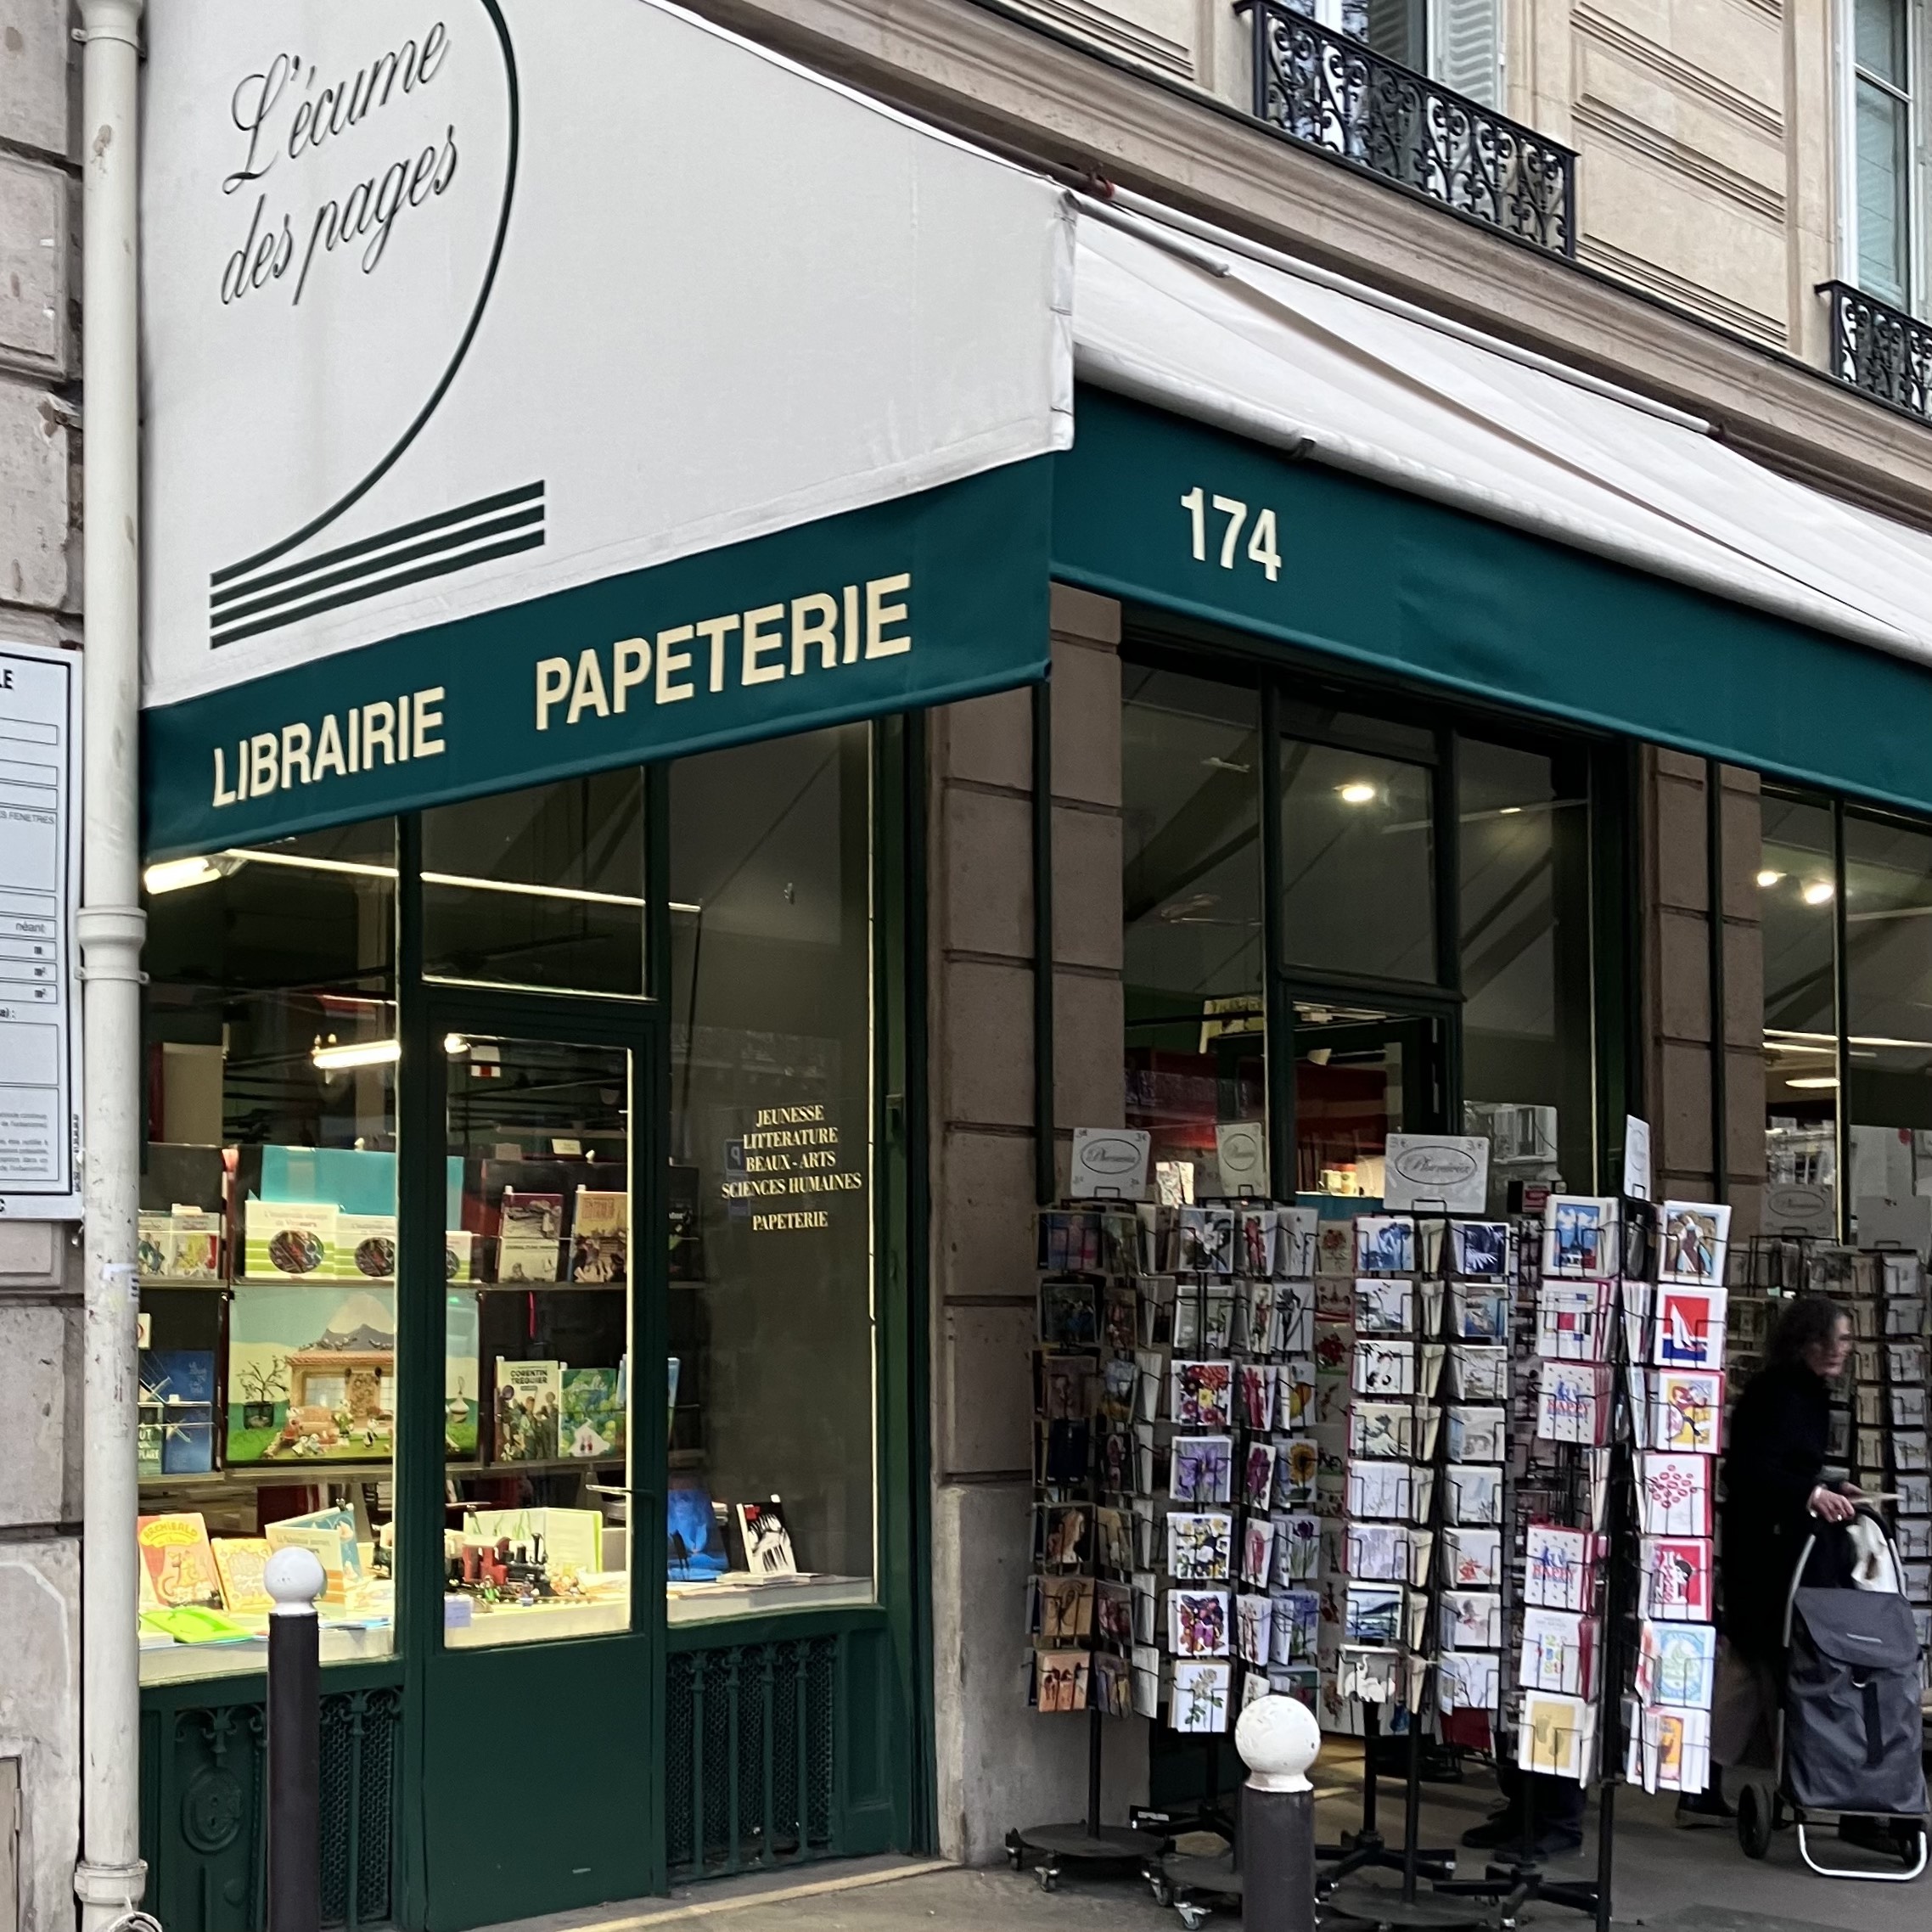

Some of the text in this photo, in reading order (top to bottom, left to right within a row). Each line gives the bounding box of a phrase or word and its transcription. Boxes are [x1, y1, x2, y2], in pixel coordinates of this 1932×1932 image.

[222, 21, 452, 194] L'écume
[221, 124, 458, 306] des pages
[1181, 486, 1282, 582] 174
[0, 669, 14, 690] E
[212, 573, 912, 807] LIBRAIRIE PAPETERIE
[755, 1104, 825, 1128] JEUNESSE
[743, 1126, 840, 1150] LITTERATURE
[745, 1154, 791, 1172] BEAUX
[799, 1150, 836, 1170] ARTS
[722, 1171, 862, 1199] SCIENCES HUMAINES
[752, 1210, 829, 1231] PAPETERIE
